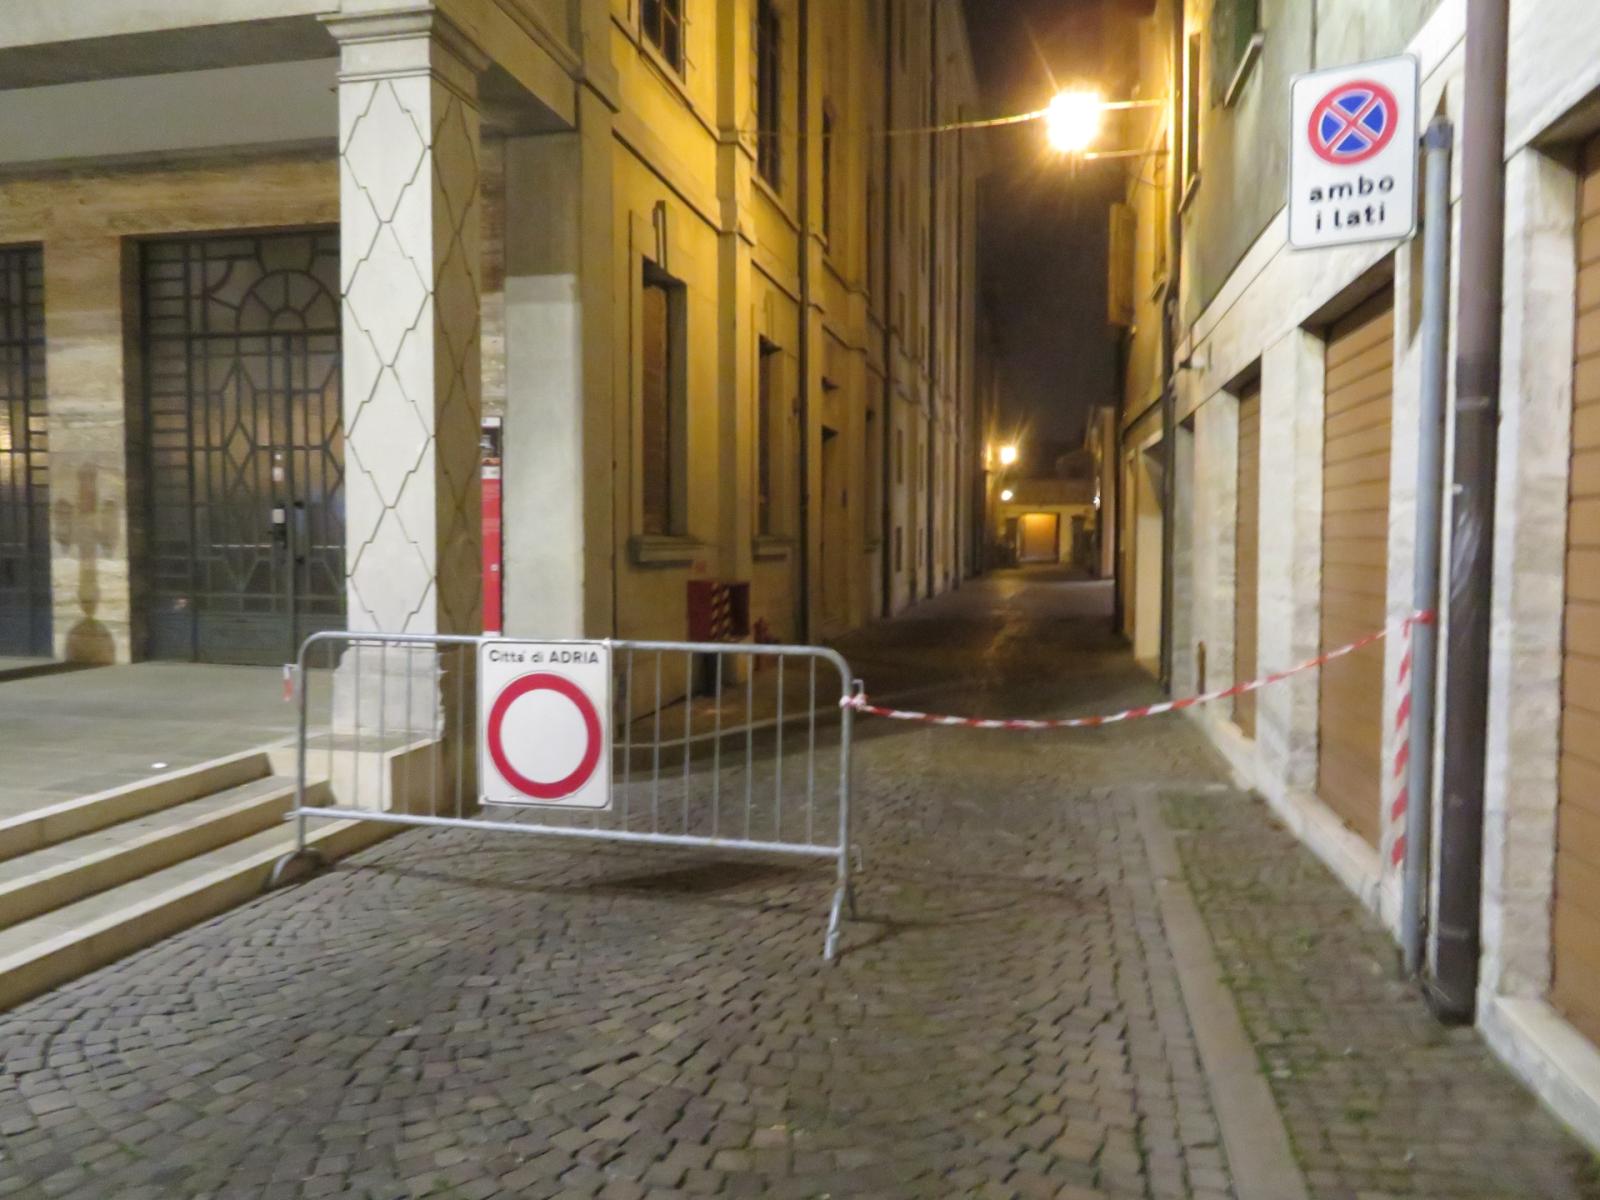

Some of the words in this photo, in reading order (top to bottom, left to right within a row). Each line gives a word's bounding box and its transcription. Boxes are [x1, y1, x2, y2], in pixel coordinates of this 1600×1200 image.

[1310, 174, 1394, 202] ambo
[1334, 203, 1385, 227] lati
[531, 650, 544, 663] di
[549, 650, 599, 664] ADRIA
